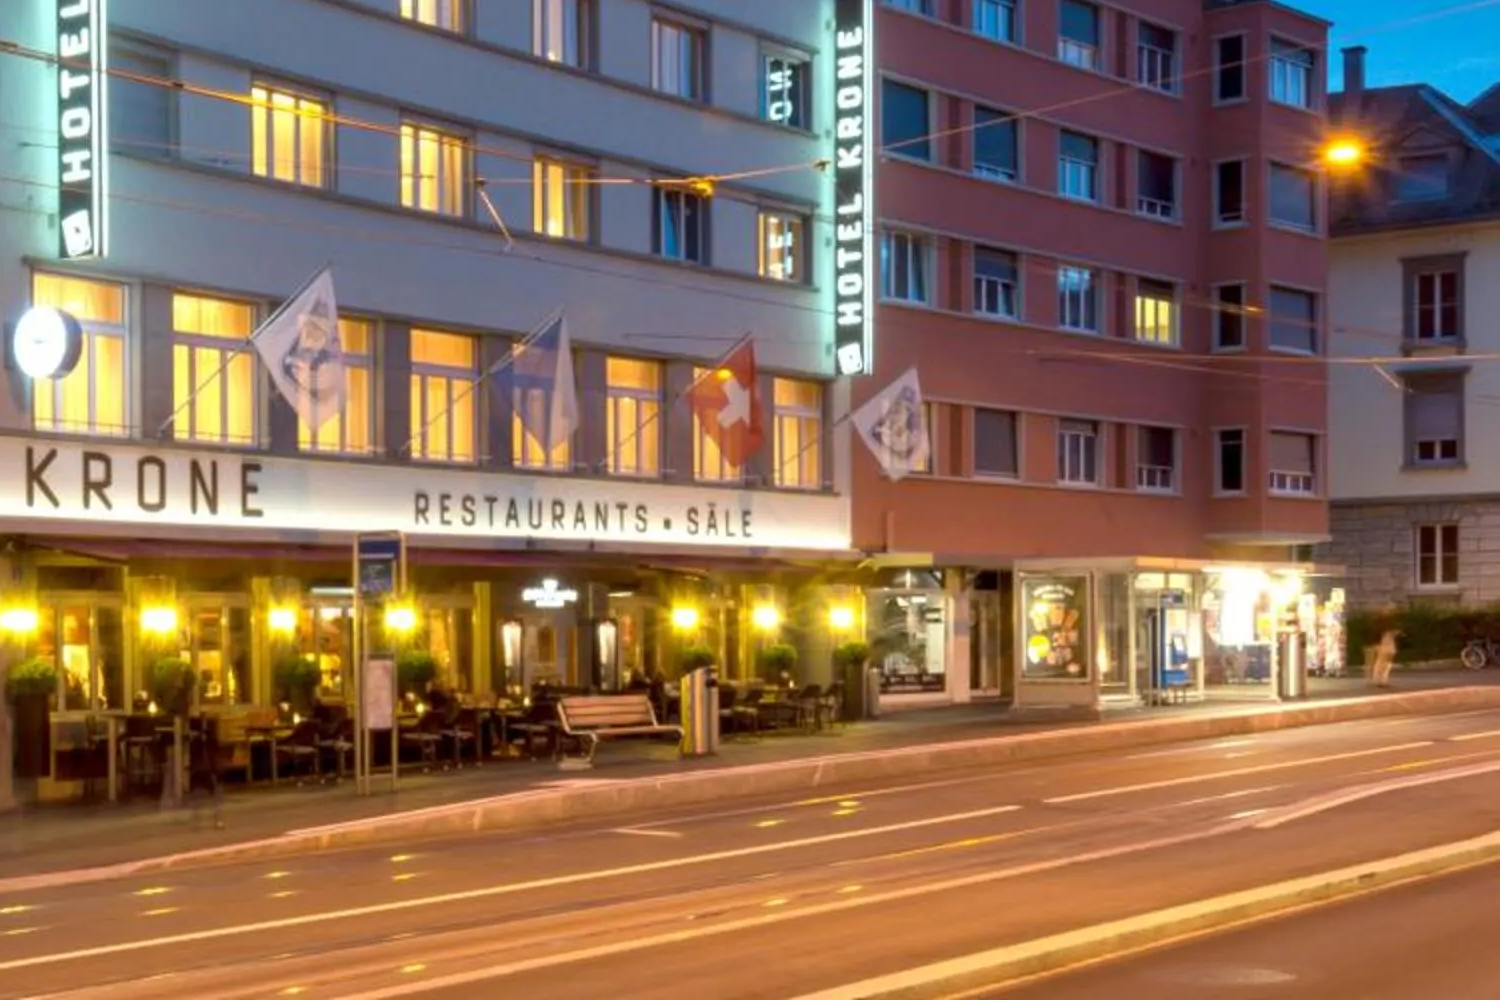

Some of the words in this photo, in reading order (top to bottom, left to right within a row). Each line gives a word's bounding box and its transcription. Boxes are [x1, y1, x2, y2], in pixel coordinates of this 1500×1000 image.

[837, 25, 863, 169] KRONE
[837, 192, 863, 326] HOTEL
[25, 445, 265, 518] KRONE
[413, 491, 649, 534] RESTAURANTS
[686, 502, 754, 538] SÄLE
